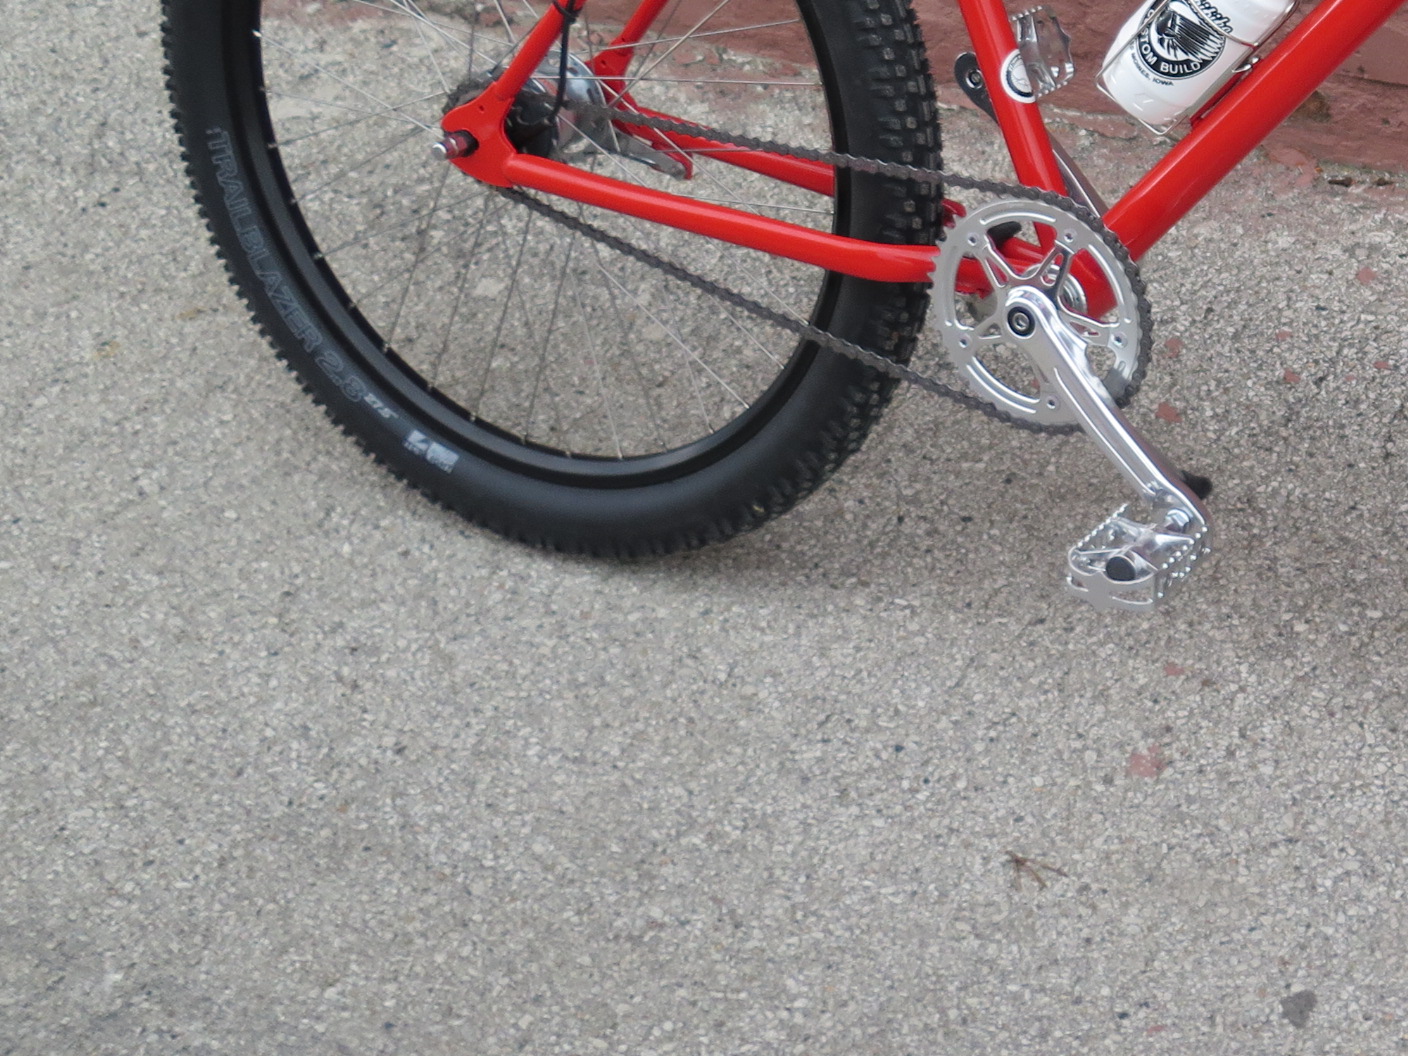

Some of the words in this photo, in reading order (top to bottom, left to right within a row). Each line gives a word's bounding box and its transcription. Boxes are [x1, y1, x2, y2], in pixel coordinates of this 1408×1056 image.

[1160, 61, 1200, 74] BUILD
[1152, 77, 1174, 86] IOWA
[204, 128, 323, 352] TRAILBLAZER
